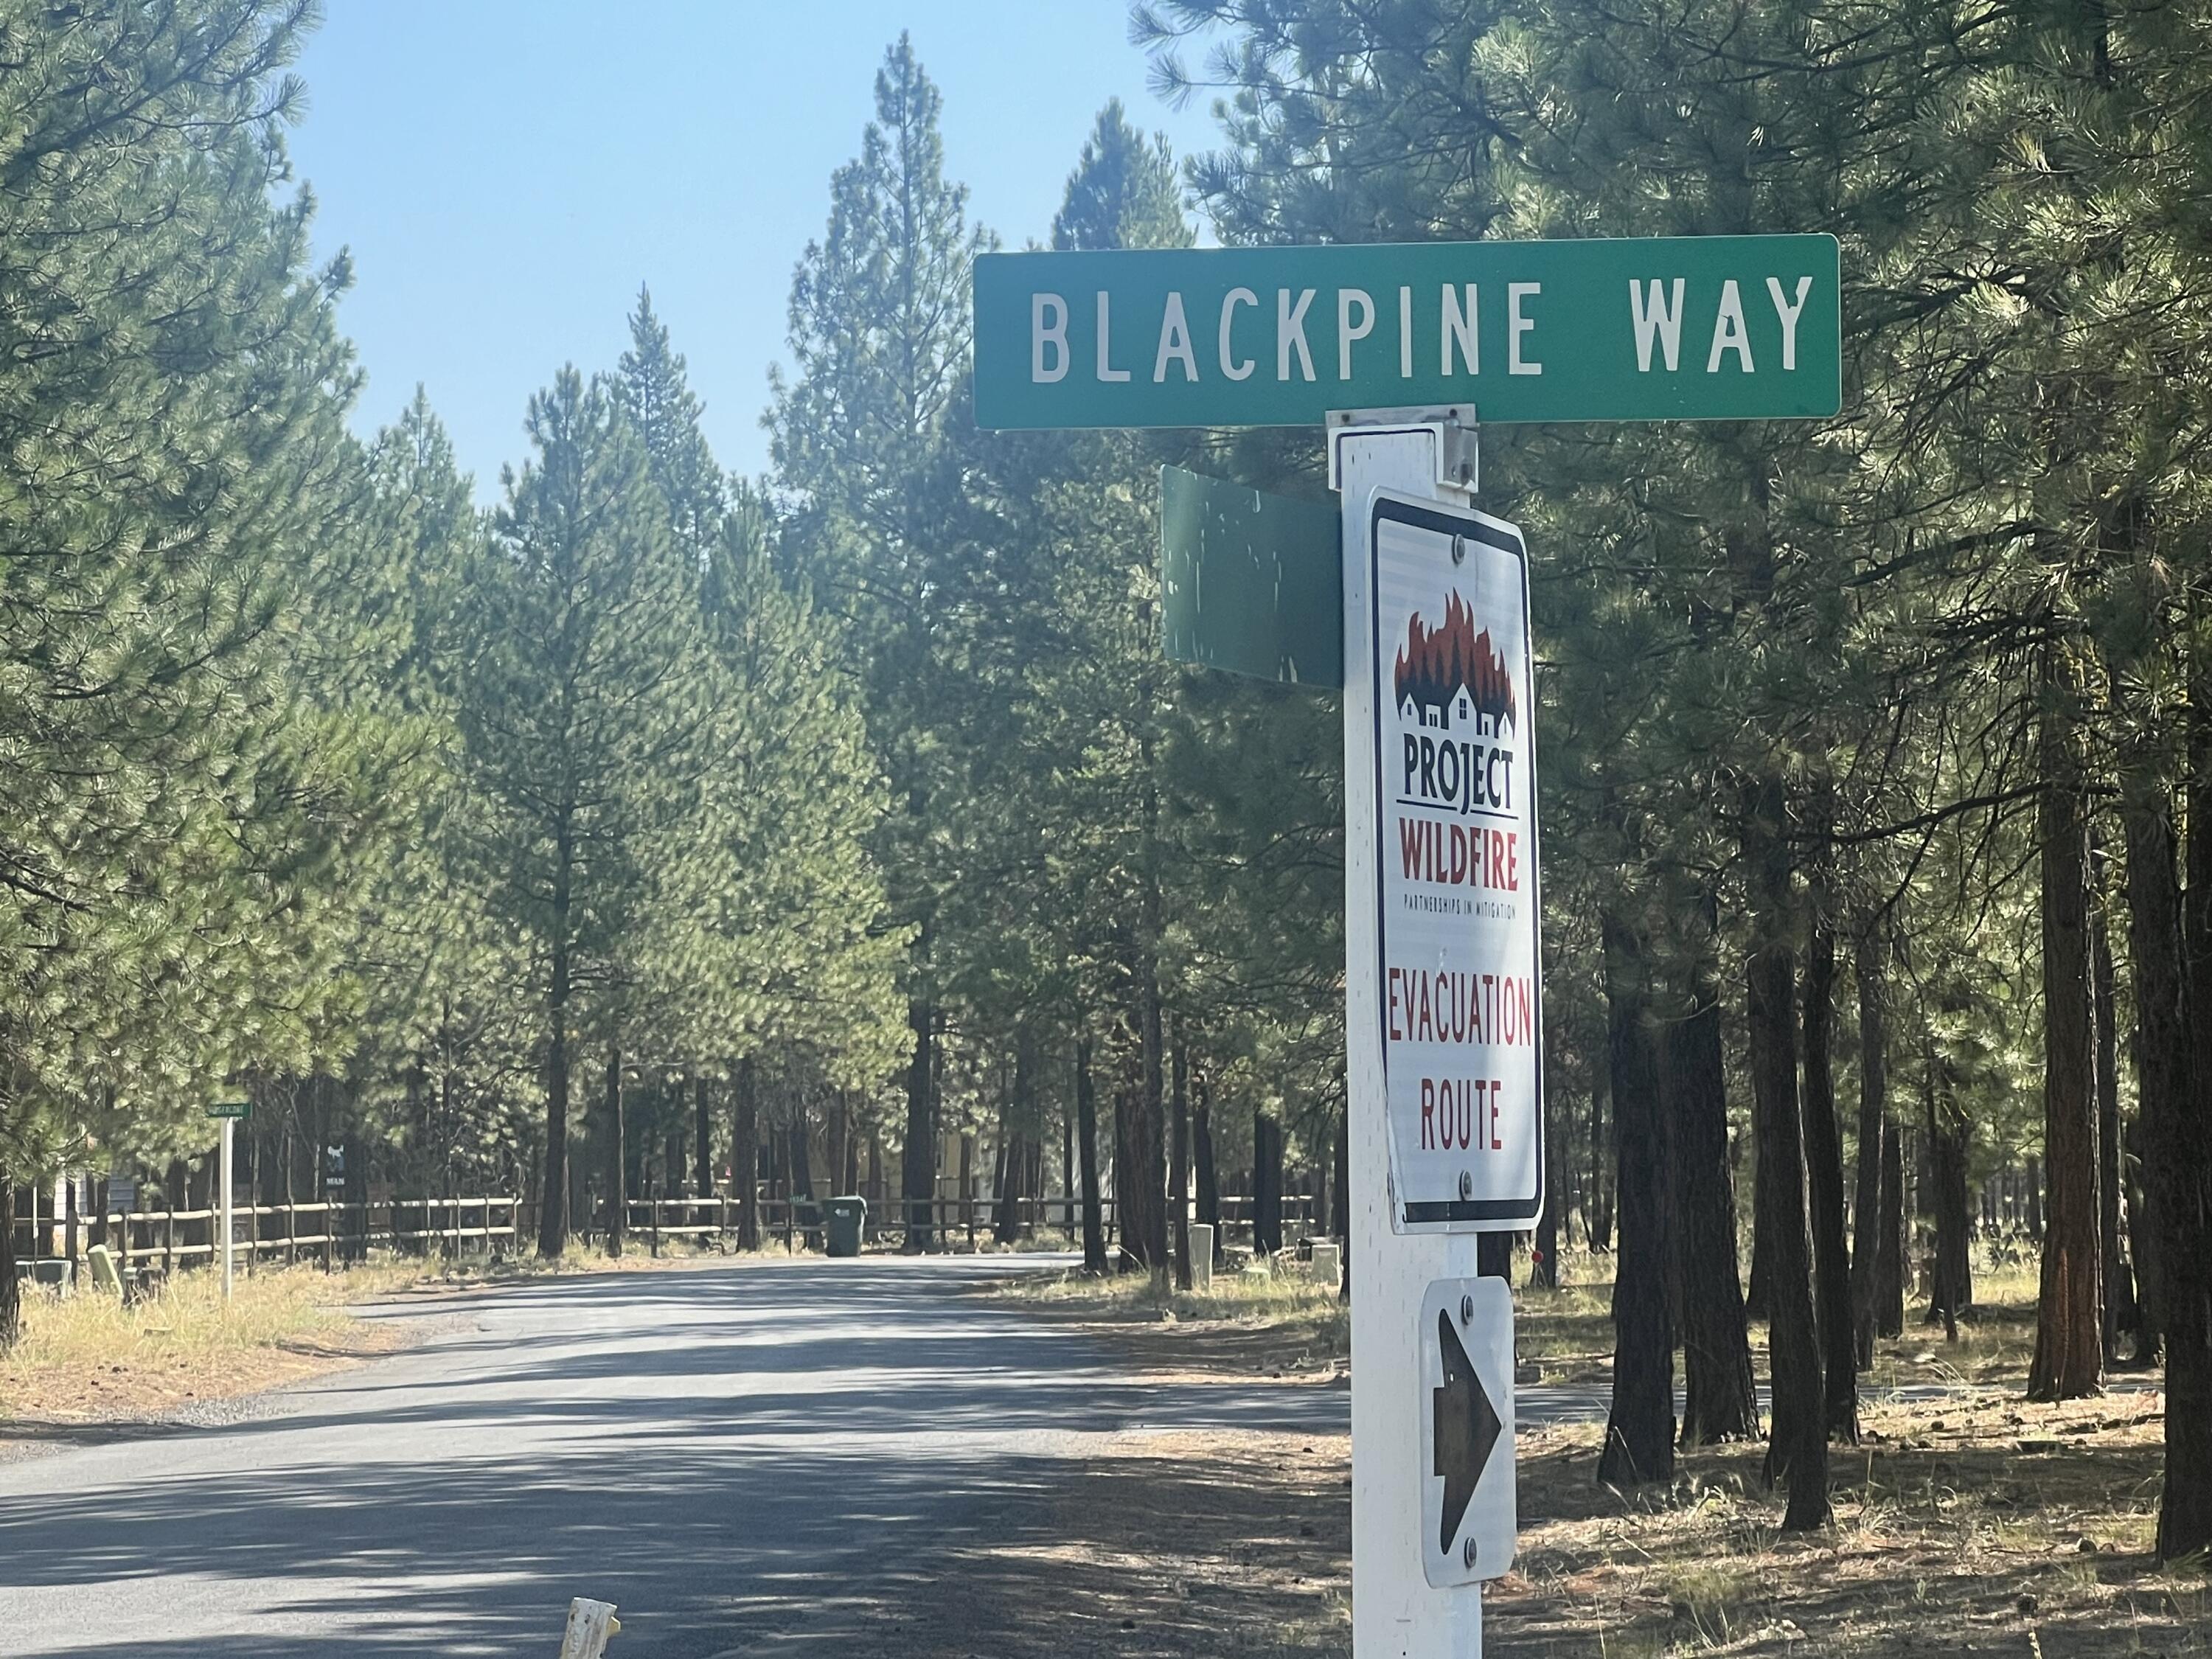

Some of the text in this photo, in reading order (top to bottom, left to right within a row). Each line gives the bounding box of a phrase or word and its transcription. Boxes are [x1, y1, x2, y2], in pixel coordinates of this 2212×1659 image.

[1032, 276, 1814, 384] BLACKPINE WAY
[1403, 733, 1514, 815] PROJECT
[1399, 817, 1518, 891] WILDFIRE
[1404, 894, 1516, 920] PARTNERSHIPS IN MITIGATION
[1388, 967, 1531, 1046] EVACUATION
[1422, 1078, 1502, 1150] ROUTE
